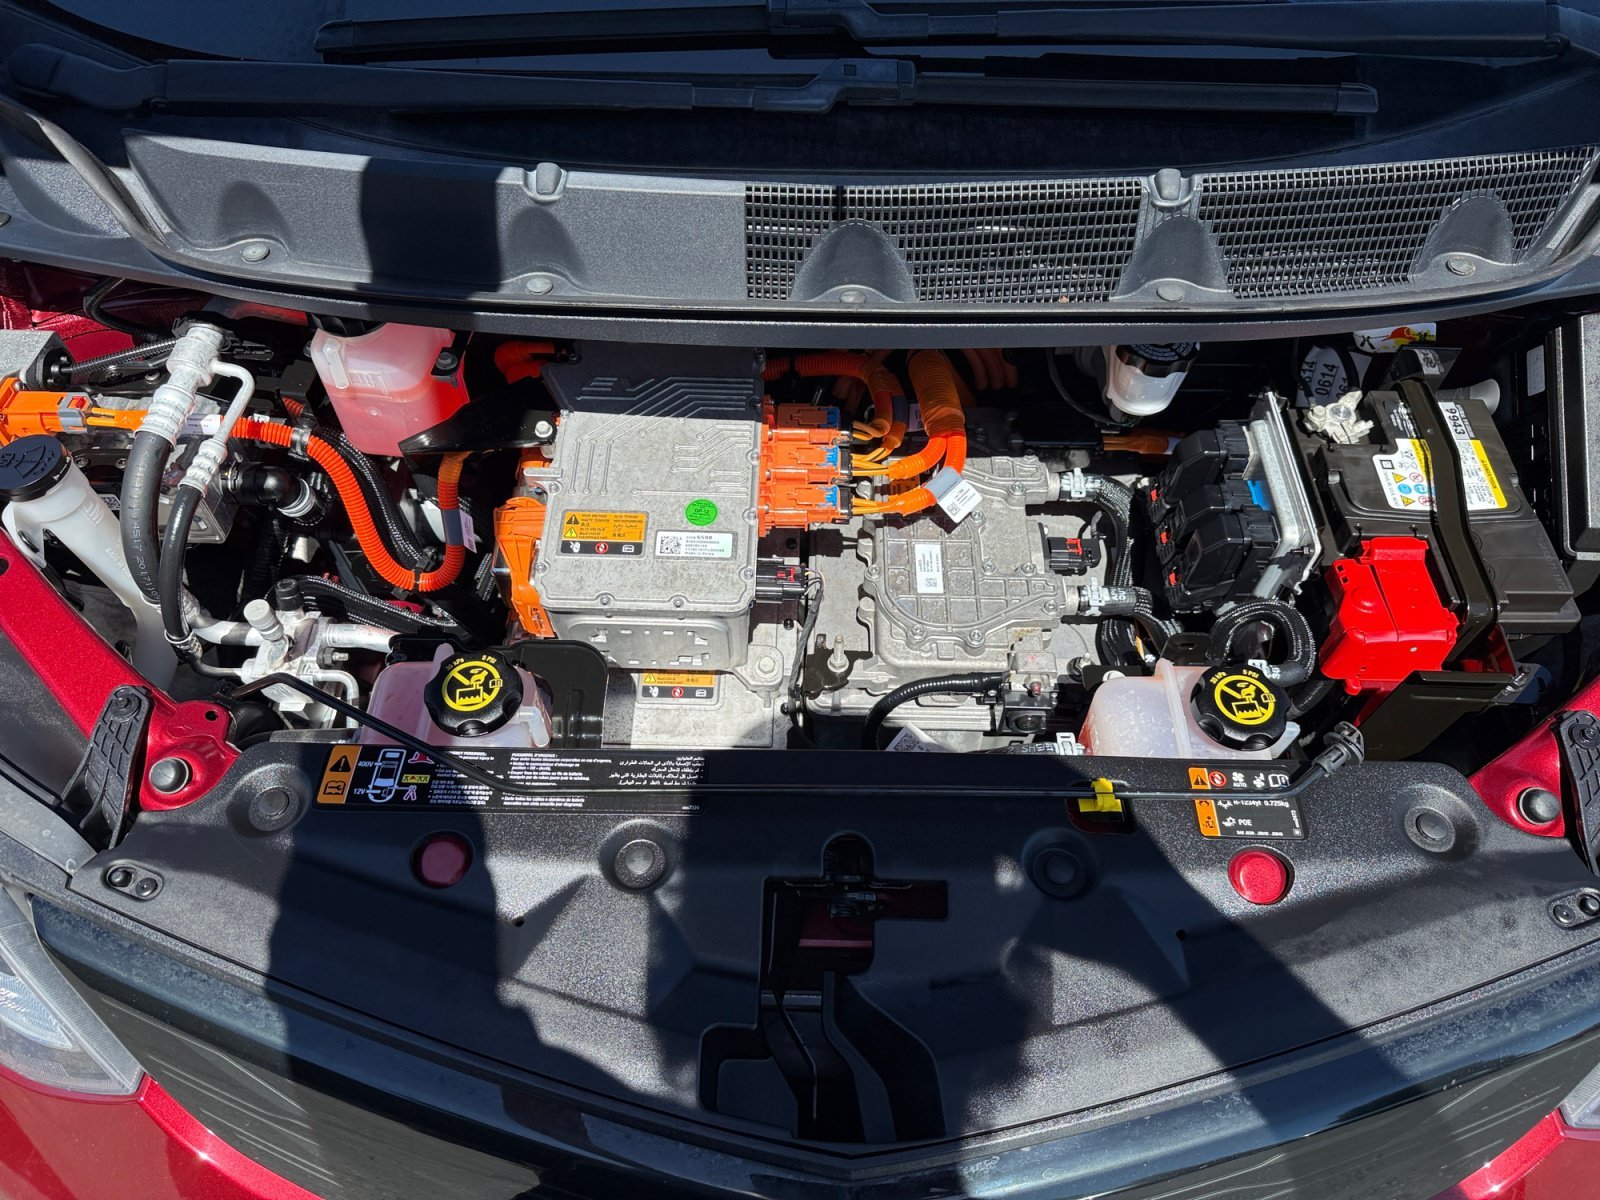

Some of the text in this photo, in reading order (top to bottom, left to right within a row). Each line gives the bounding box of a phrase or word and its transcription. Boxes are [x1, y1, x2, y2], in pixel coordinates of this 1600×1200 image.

[1315, 362, 1337, 397] 0614
[1445, 407, 1465, 436] 9943
[1248, 671, 1260, 679] PSI
[1238, 818, 1253, 826] POE
